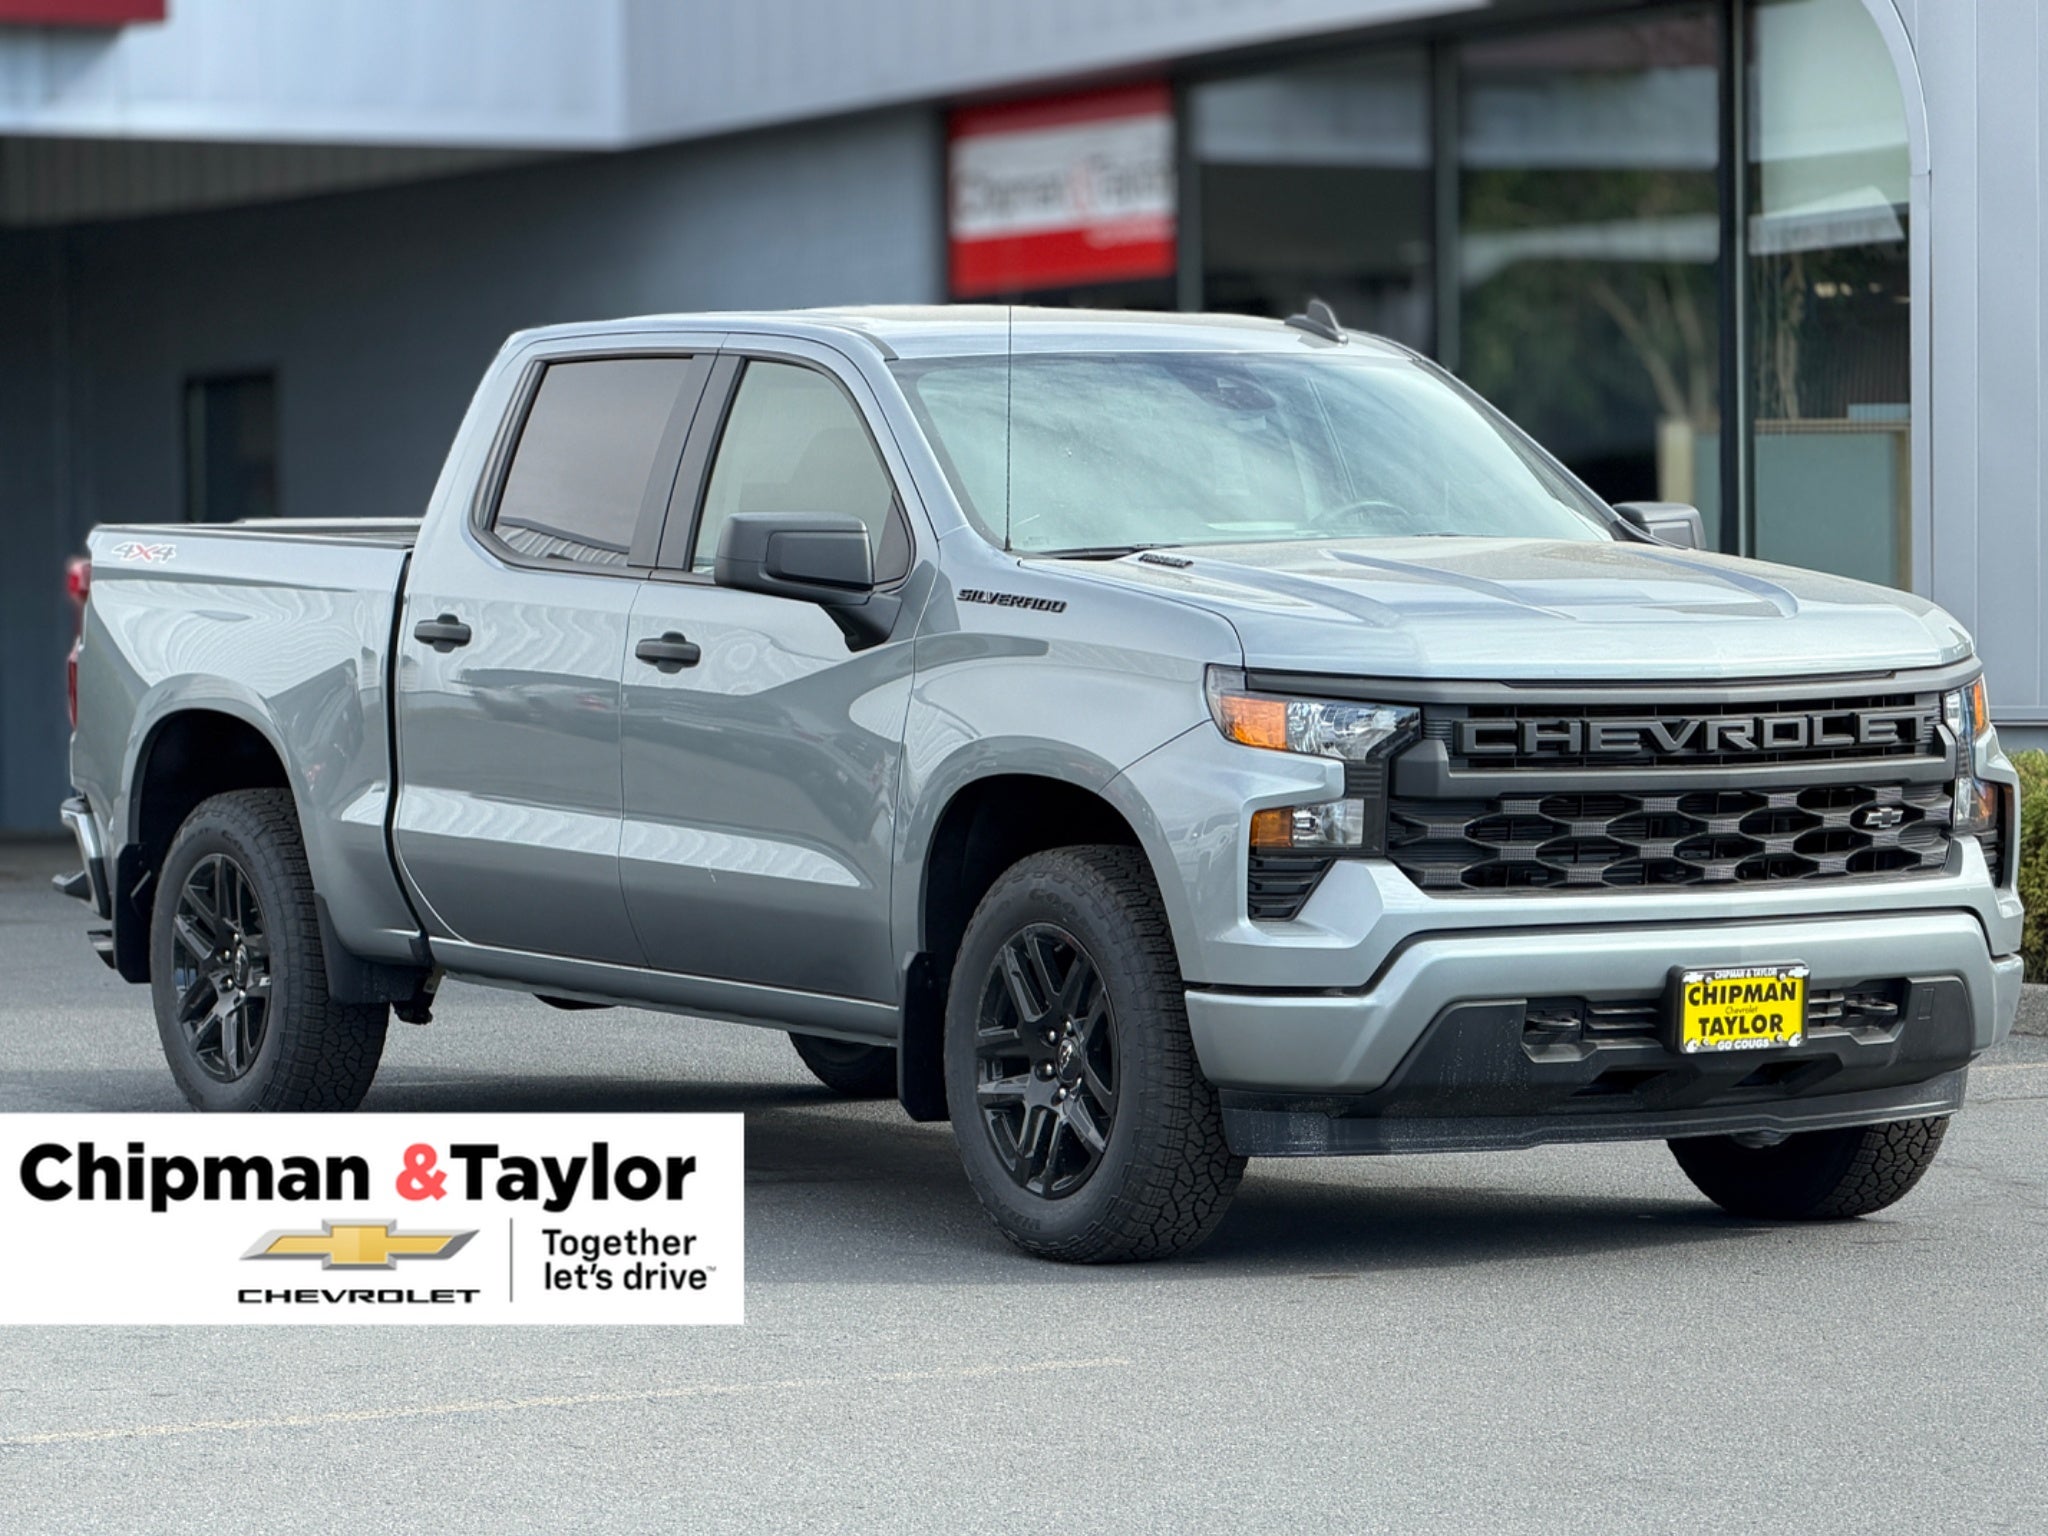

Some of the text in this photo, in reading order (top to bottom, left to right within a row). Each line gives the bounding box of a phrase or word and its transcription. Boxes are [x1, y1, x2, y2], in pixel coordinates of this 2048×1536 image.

[957, 588, 1067, 613] SILVERADO
[1456, 709, 1940, 754] CHEVROLET
[1688, 982, 1796, 1006] CHIPMAN
[1725, 1005, 1758, 1015] Chevrolet
[1698, 1014, 1783, 1036] TAYLOR
[1717, 1038, 1769, 1051] GO COUGS
